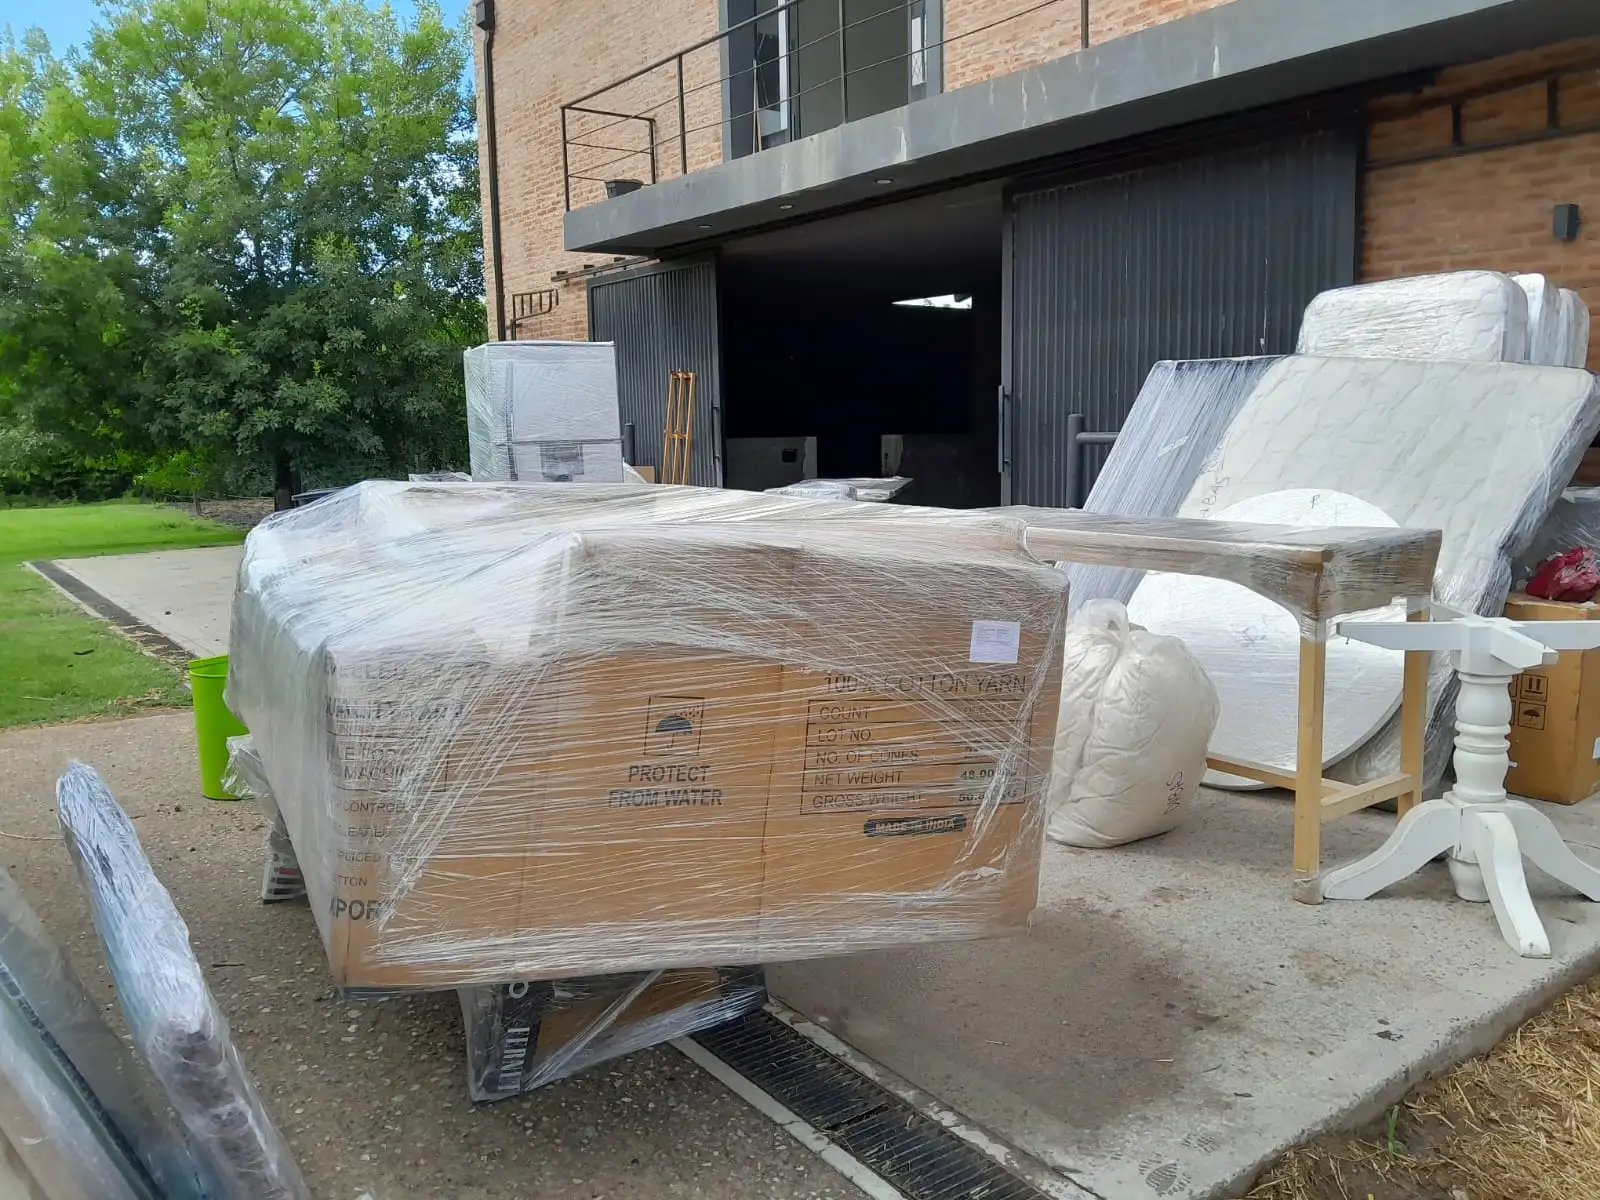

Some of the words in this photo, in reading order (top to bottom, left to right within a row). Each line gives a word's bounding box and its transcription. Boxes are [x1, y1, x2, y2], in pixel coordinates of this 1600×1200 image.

[976, 674, 1025, 693] YARN
[819, 706, 870, 720] COUNT
[817, 728, 845, 742] LOT
[628, 764, 711, 782] PROTECT
[814, 772, 844, 786] NET
[847, 770, 904, 785] WEIGHT
[607, 790, 659, 808] FROM
[664, 788, 723, 806] WATER
[812, 793, 864, 809] GROSS
